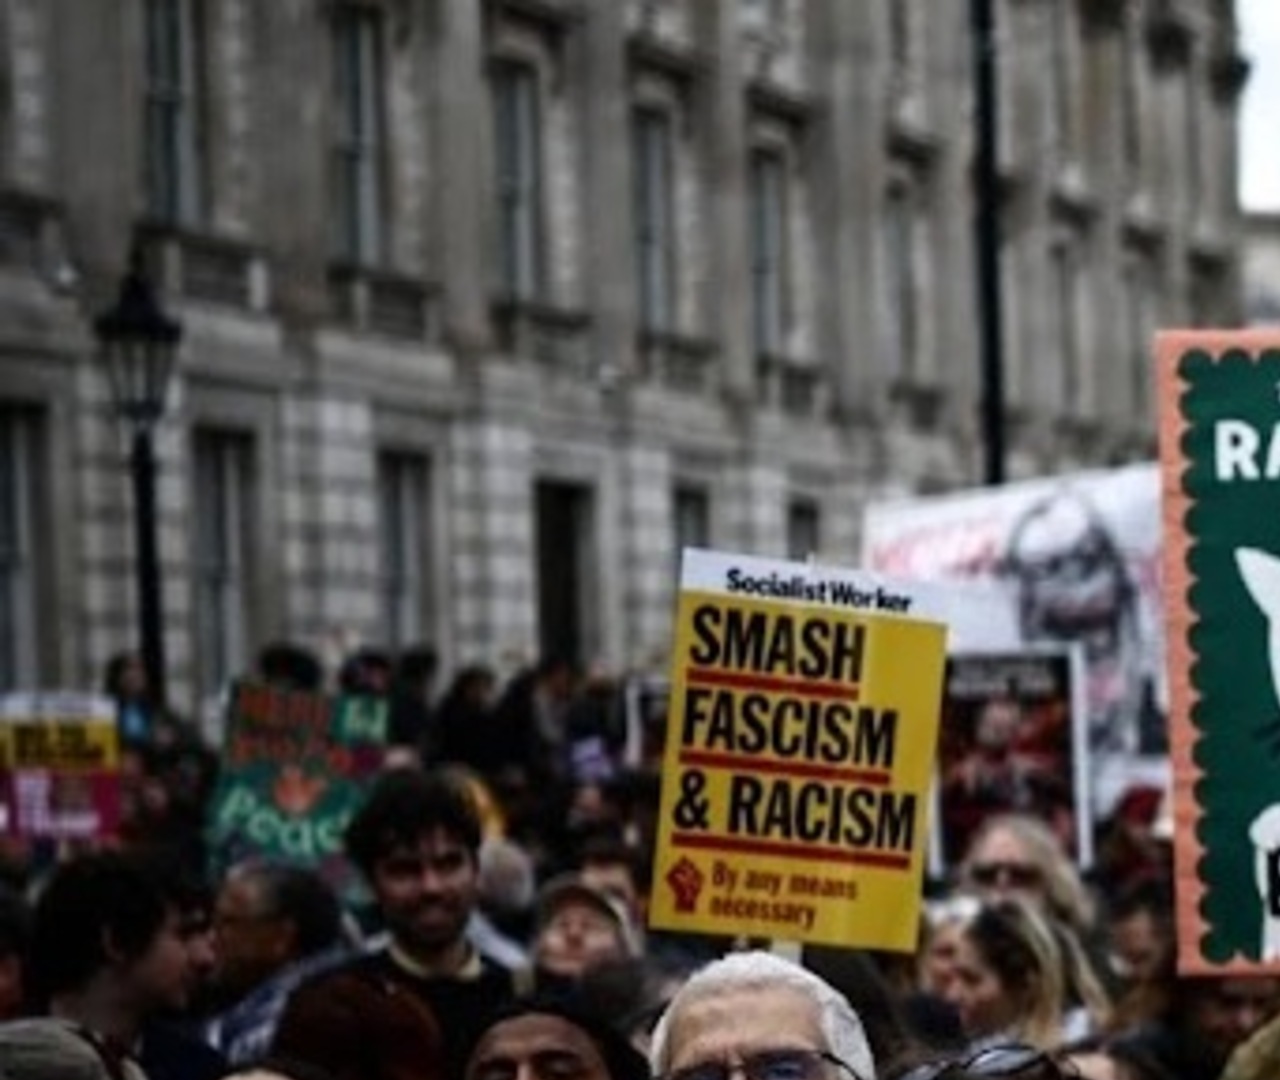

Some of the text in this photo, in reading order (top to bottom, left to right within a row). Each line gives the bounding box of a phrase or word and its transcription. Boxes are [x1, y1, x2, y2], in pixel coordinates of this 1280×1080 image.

[689, 604, 866, 682] SMASH
[682, 688, 898, 767] FASCISM
[672, 768, 917, 853] & RACISM
[708, 895, 816, 931] necessary
[712, 860, 858, 900] By any means
